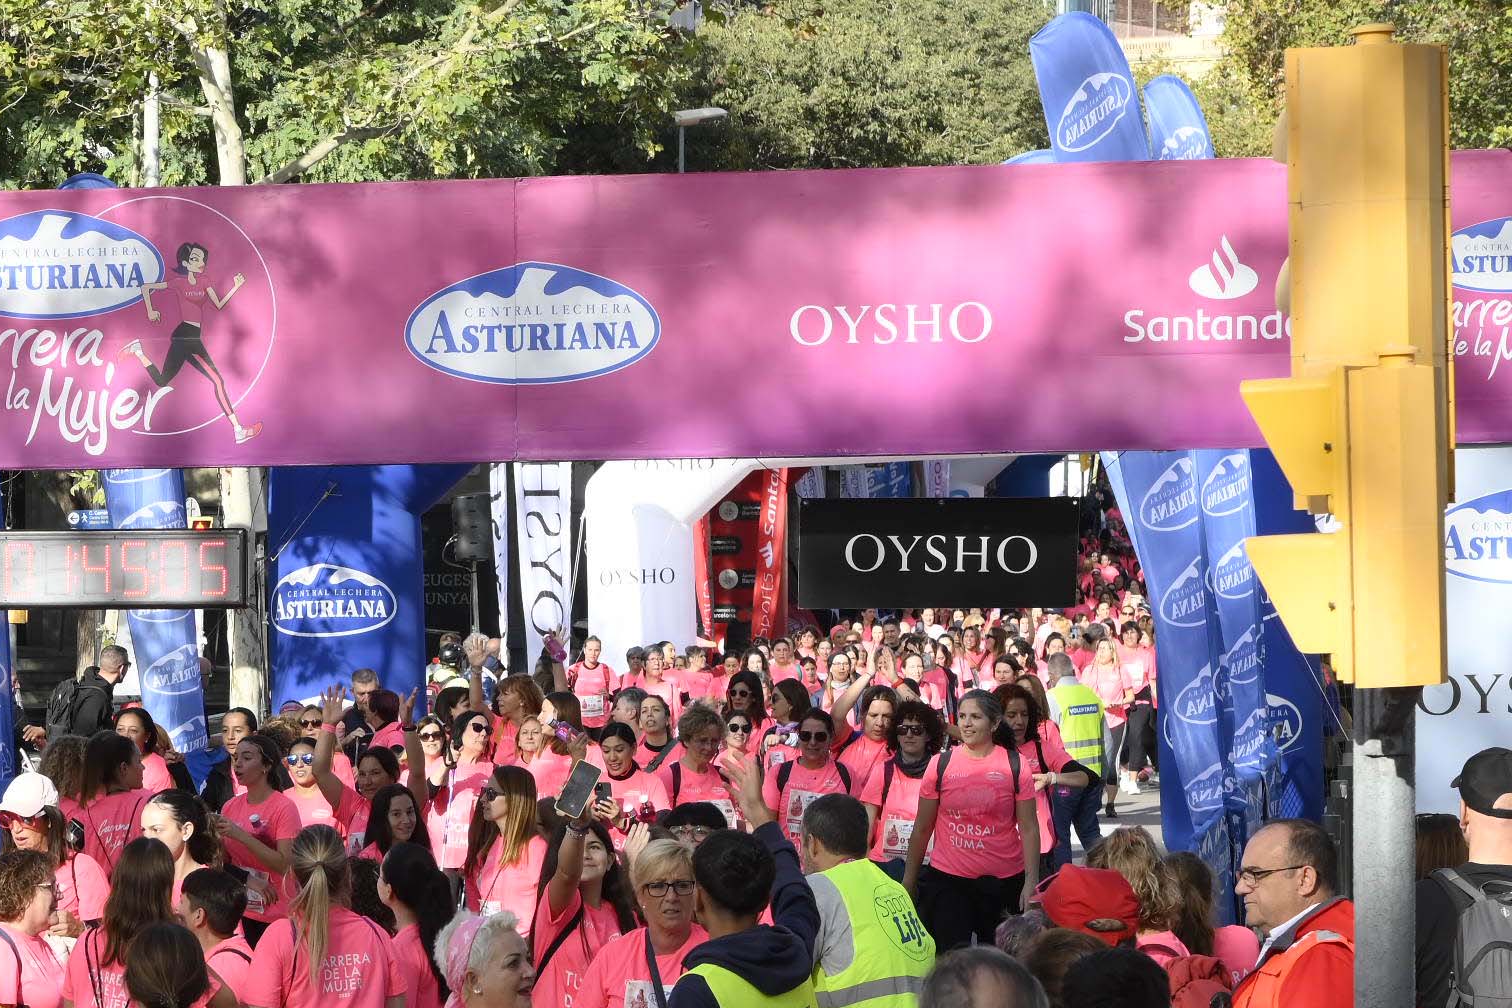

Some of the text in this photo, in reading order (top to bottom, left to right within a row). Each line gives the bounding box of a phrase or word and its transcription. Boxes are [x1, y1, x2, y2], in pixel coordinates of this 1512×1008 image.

[68, 246, 139, 257] LECHERA
[464, 303, 633, 318] CENTRAL LECHERA
[790, 301, 993, 346] OYSHO
[425, 309, 641, 355] ASTURIANA
[1123, 309, 1293, 344] Santand
[1474, 327, 1492, 357] la
[7, 371, 30, 410] la
[25, 362, 174, 456] Mujer
[844, 532, 1038, 574] OYSHO
[599, 567, 676, 586] OYSHO
[276, 592, 388, 620] ASTURIANA
[288, 588, 383, 598] CENTRAL LECHERA
[893, 911, 926, 947] Life
[322, 951, 371, 967] ARRERA
[324, 966, 361, 981] DE LA
